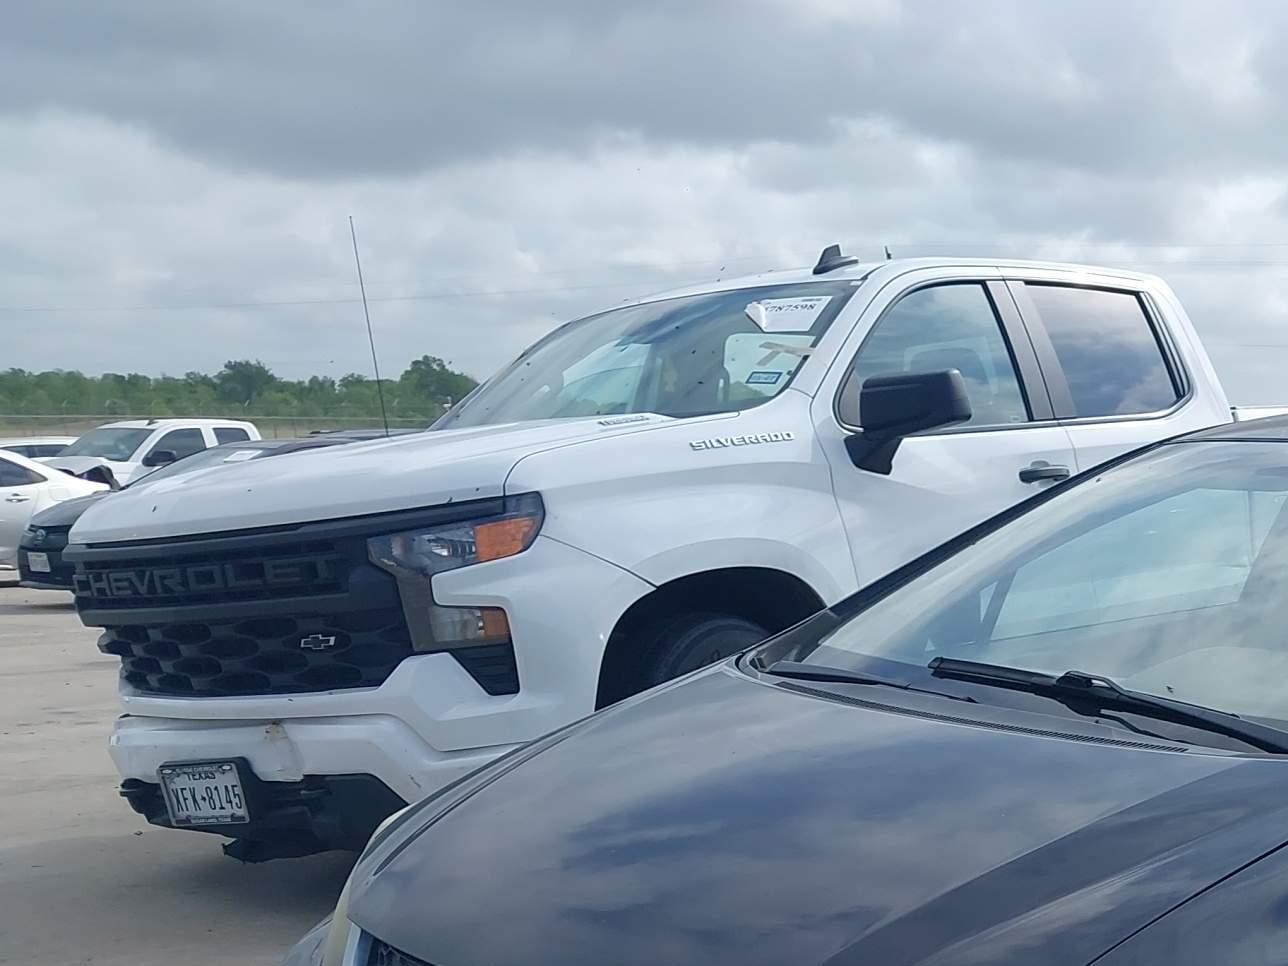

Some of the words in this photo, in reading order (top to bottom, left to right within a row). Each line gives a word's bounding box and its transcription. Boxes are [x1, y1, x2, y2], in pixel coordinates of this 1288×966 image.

[689, 431, 795, 451] SILVERADO
[73, 552, 340, 598] CHEVROLET
[184, 770, 216, 781] TEXAS
